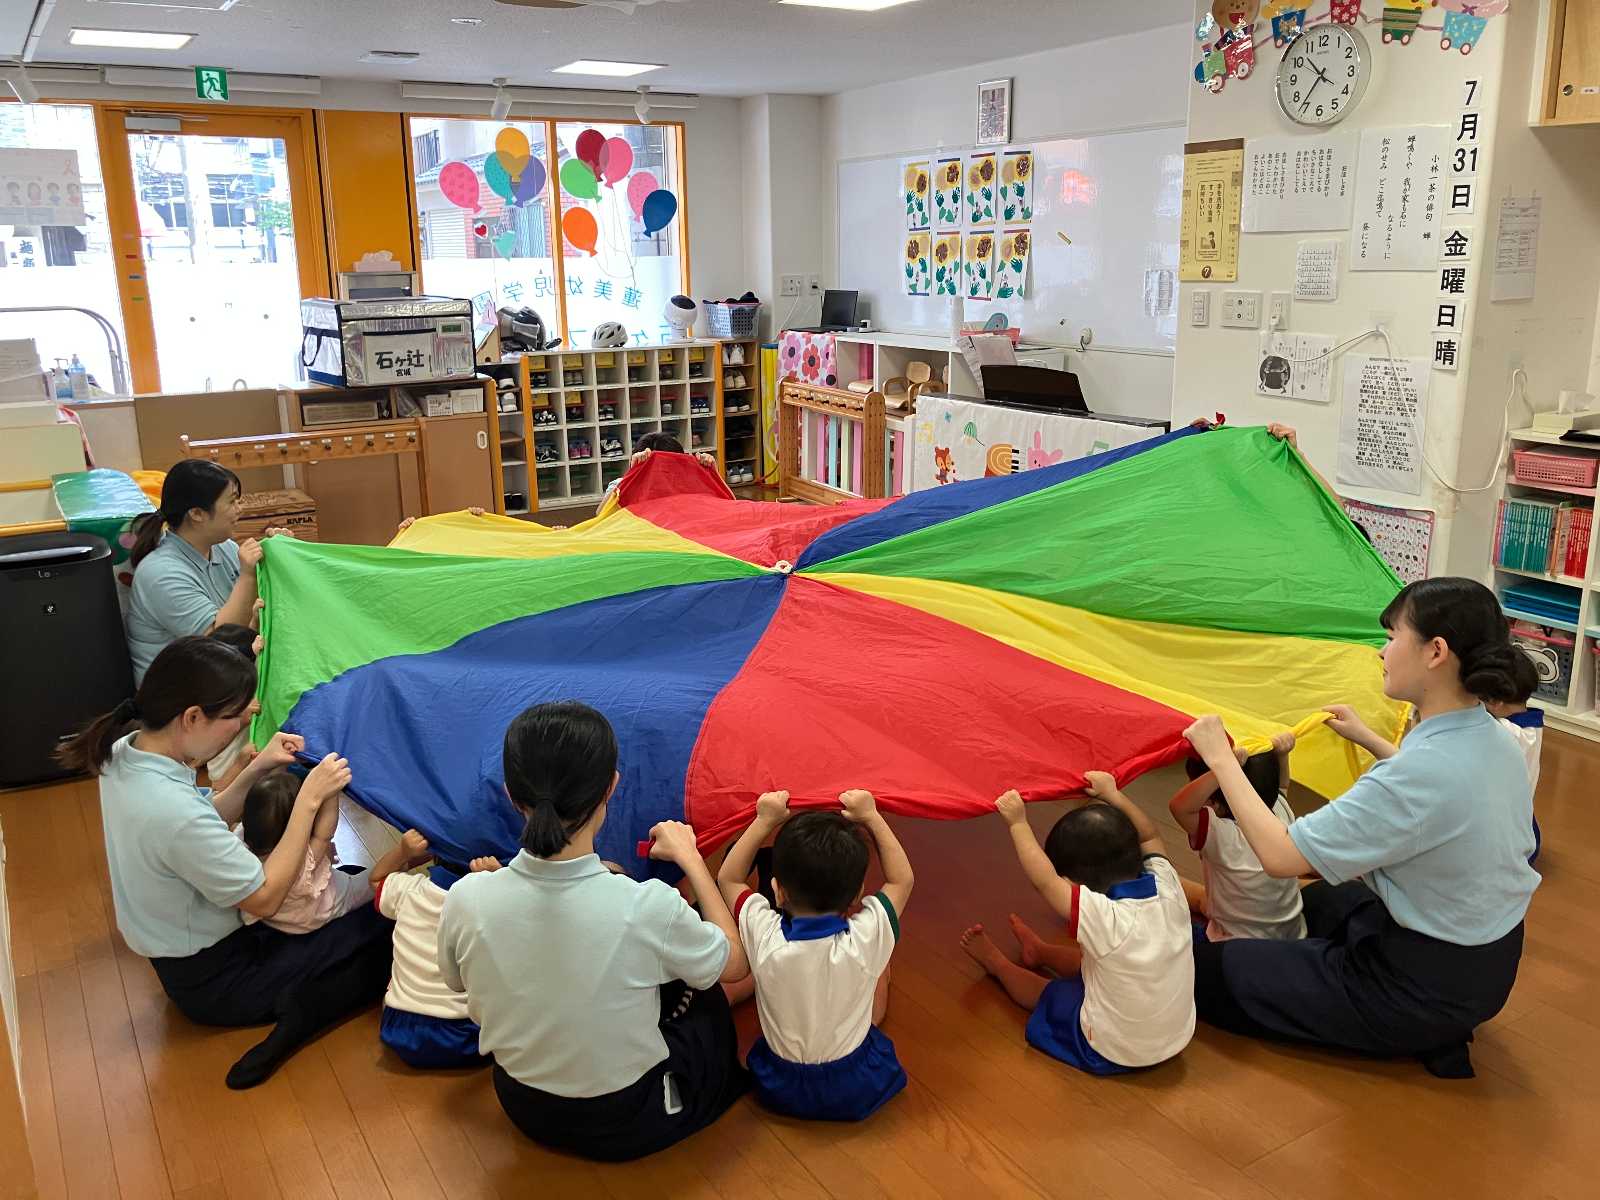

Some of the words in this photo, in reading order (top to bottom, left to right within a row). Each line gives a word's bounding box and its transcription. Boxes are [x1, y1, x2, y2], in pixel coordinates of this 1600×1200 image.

[1306, 40, 1314, 53] 11
[1319, 34, 1329, 47] 12
[1345, 46, 1353, 58] 2
[1293, 56, 1304, 68] 10
[1347, 65, 1355, 77] 3
[1289, 74, 1297, 85] 9
[1341, 83, 1349, 95] 4
[1293, 91, 1300, 102] 8
[1302, 102, 1310, 114] 7
[1315, 104, 1323, 116] 6
[1331, 98, 1339, 110] 5
[1425, 154, 1440, 222] 小林一茶の俳句
